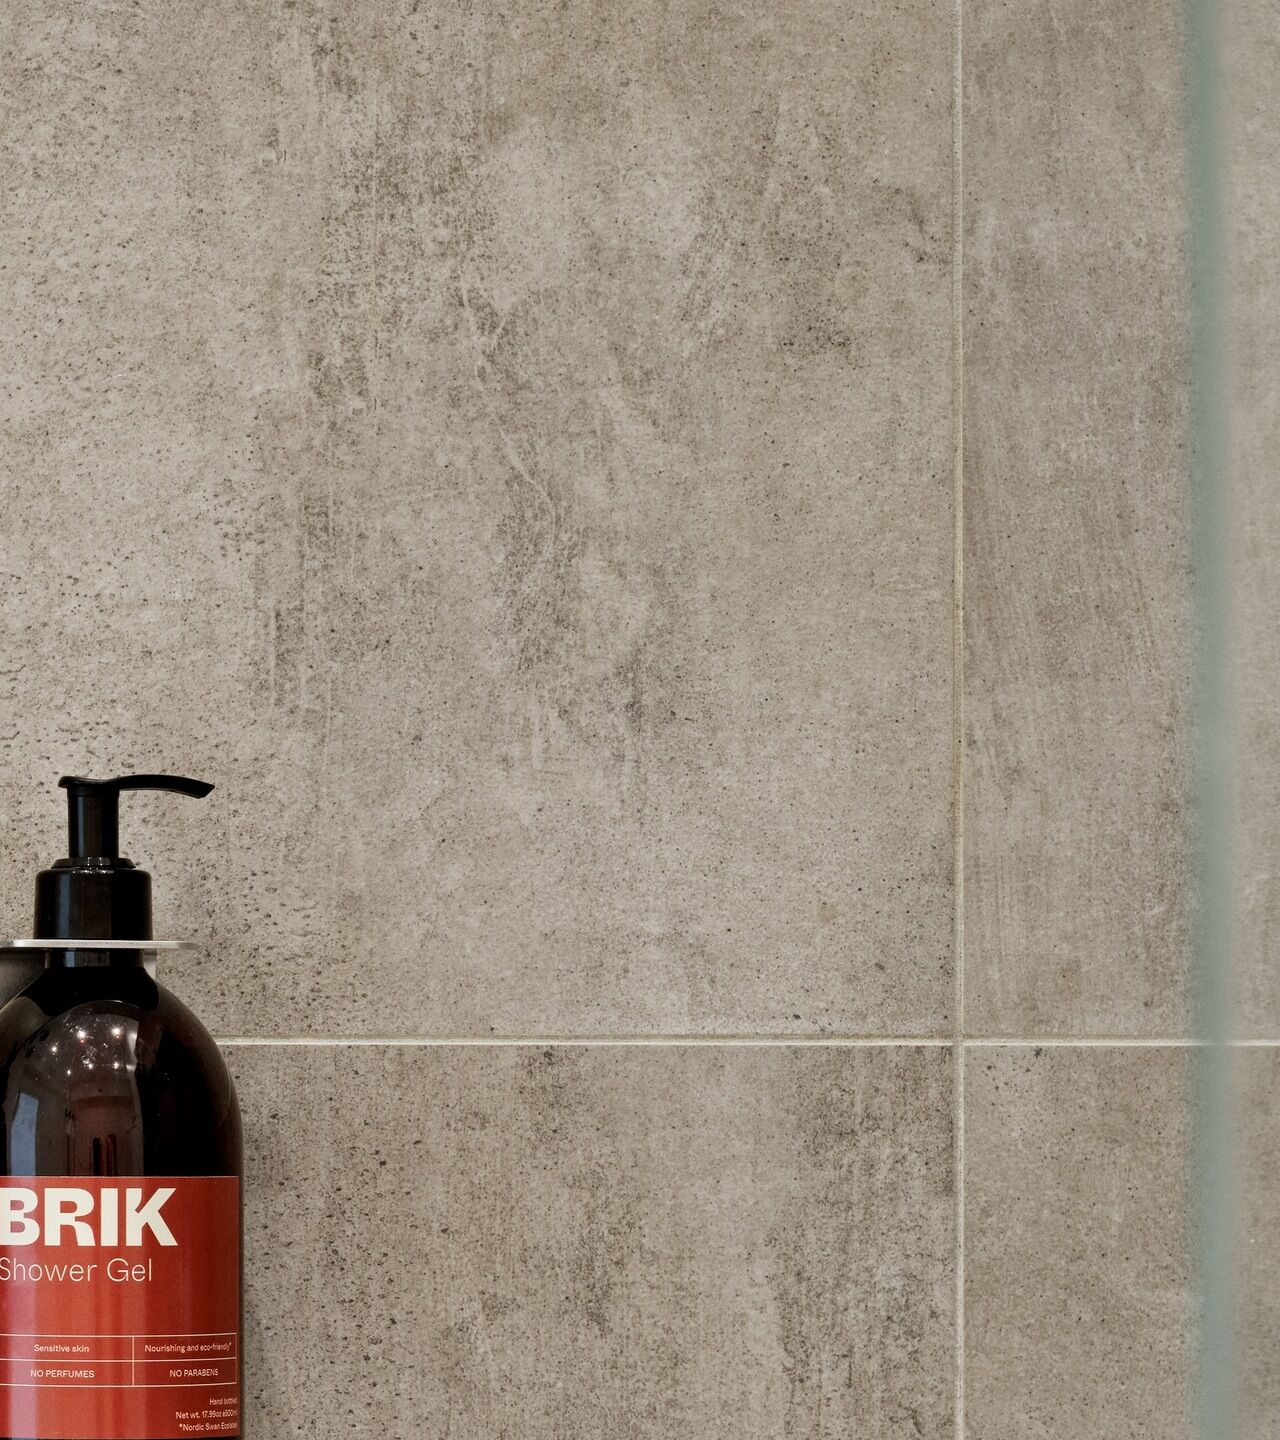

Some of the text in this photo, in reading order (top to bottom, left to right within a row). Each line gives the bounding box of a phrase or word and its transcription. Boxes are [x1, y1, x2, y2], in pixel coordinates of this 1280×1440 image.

[107, 1258, 152, 1282] Gel
[34, 1344, 70, 1353] Sensitive
[144, 1344, 186, 1353] Nourishing
[30, 1369, 95, 1378] NO PERFUMES
[169, 1368, 219, 1378] NO PARABENS
[175, 1411, 189, 1419] Net
[205, 1423, 220, 1431] Swan
